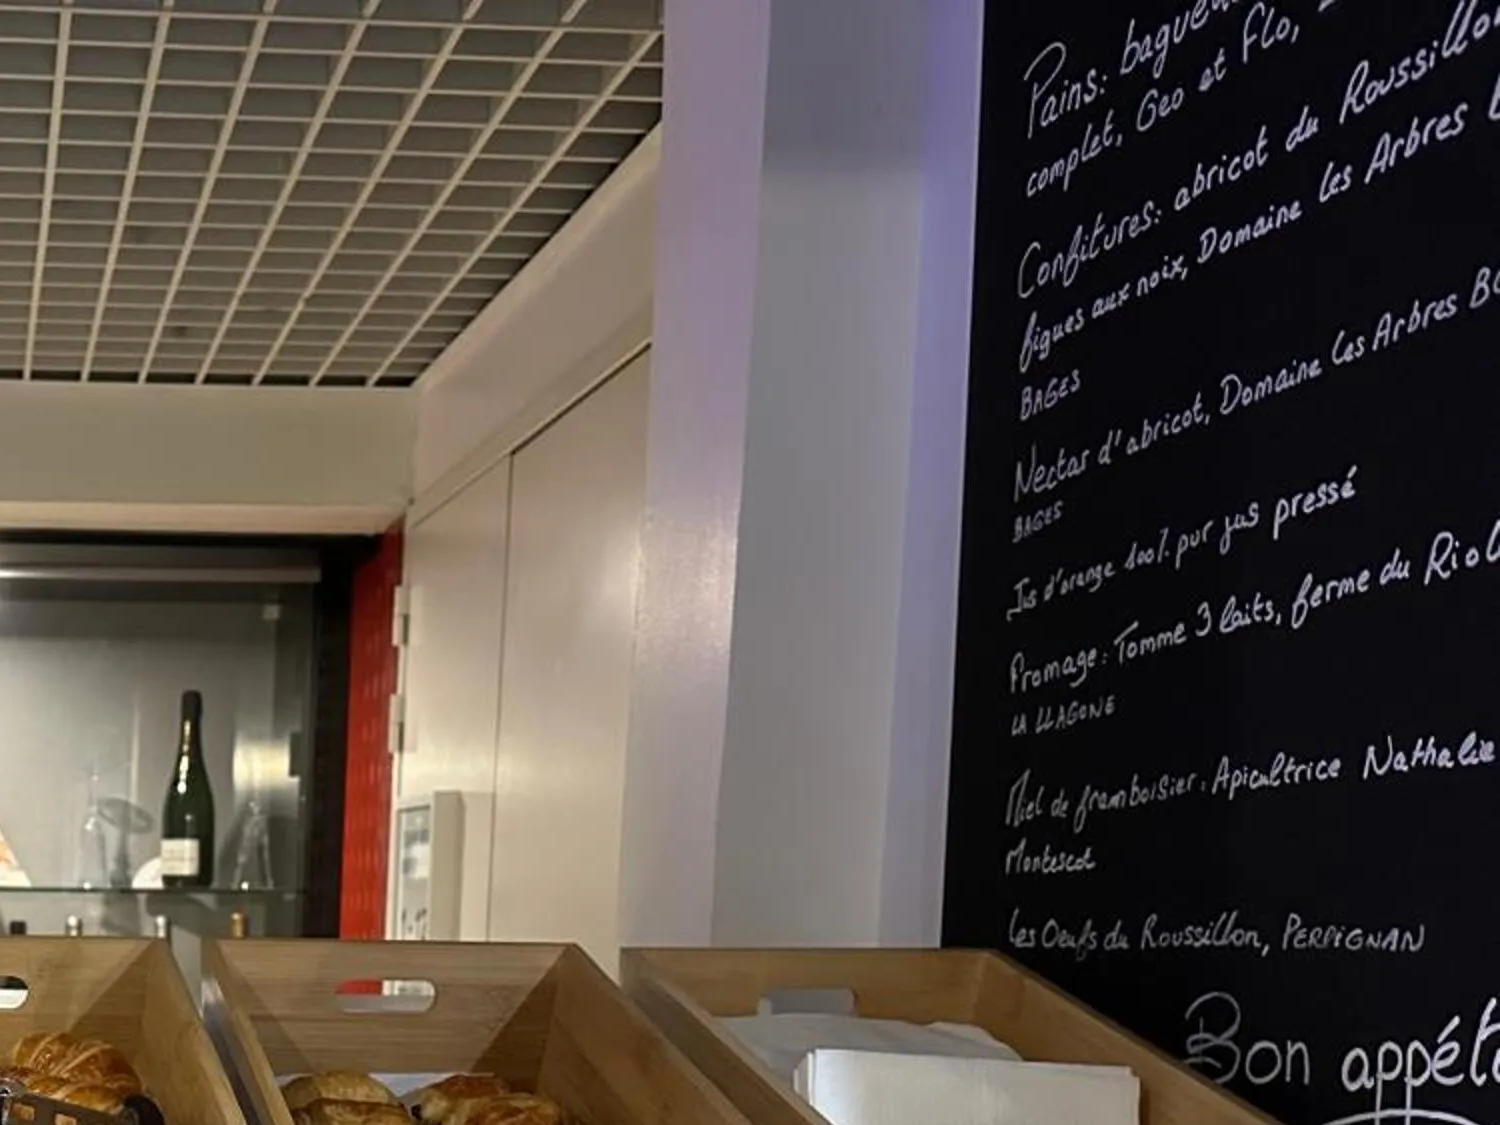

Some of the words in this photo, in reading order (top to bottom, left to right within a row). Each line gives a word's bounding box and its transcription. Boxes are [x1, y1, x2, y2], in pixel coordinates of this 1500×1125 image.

[1024, 42, 1107, 139] Pains:
[1027, 109, 1123, 197] complet,
[1199, 48, 1227, 91] et
[1243, 2, 1299, 64] Flo,
[1018, 201, 1161, 299] Confitures:
[1175, 127, 1268, 210] abricot
[1286, 106, 1318, 151] du
[1019, 312, 1084, 373] figues
[1092, 284, 1130, 318] aux
[1137, 256, 1188, 300] noix,
[1198, 199, 1301, 264] Domaine
[1364, 103, 1468, 184] Arbres
[1013, 444, 1090, 501] Nectar
[1098, 392, 1210, 465] d'abricot,
[1220, 355, 1321, 414] Domaine
[1372, 293, 1457, 352] Arbres
[1020, 369, 1080, 421] BAGES
[1012, 501, 1063, 543] BAGES
[1176, 520, 1213, 569] pur
[1219, 502, 1259, 554] jus
[1273, 464, 1358, 540] pressé
[1114, 621, 1187, 665] Tomme
[1195, 602, 1212, 637] 3
[1219, 596, 1282, 634] laits,
[1292, 570, 1369, 629] ferme
[1379, 548, 1410, 586] du
[1011, 711, 1028, 737] LA
[1005, 768, 1043, 827] Miel
[1051, 796, 1068, 819] de
[1211, 755, 1341, 800] Apicultrice
[1363, 730, 1496, 779] Nathalie
[1041, 920, 1097, 962] Oeufs
[1103, 920, 1130, 951] du
[1140, 911, 1270, 957] Roussillon,
[1185, 991, 1310, 1085] Bon
